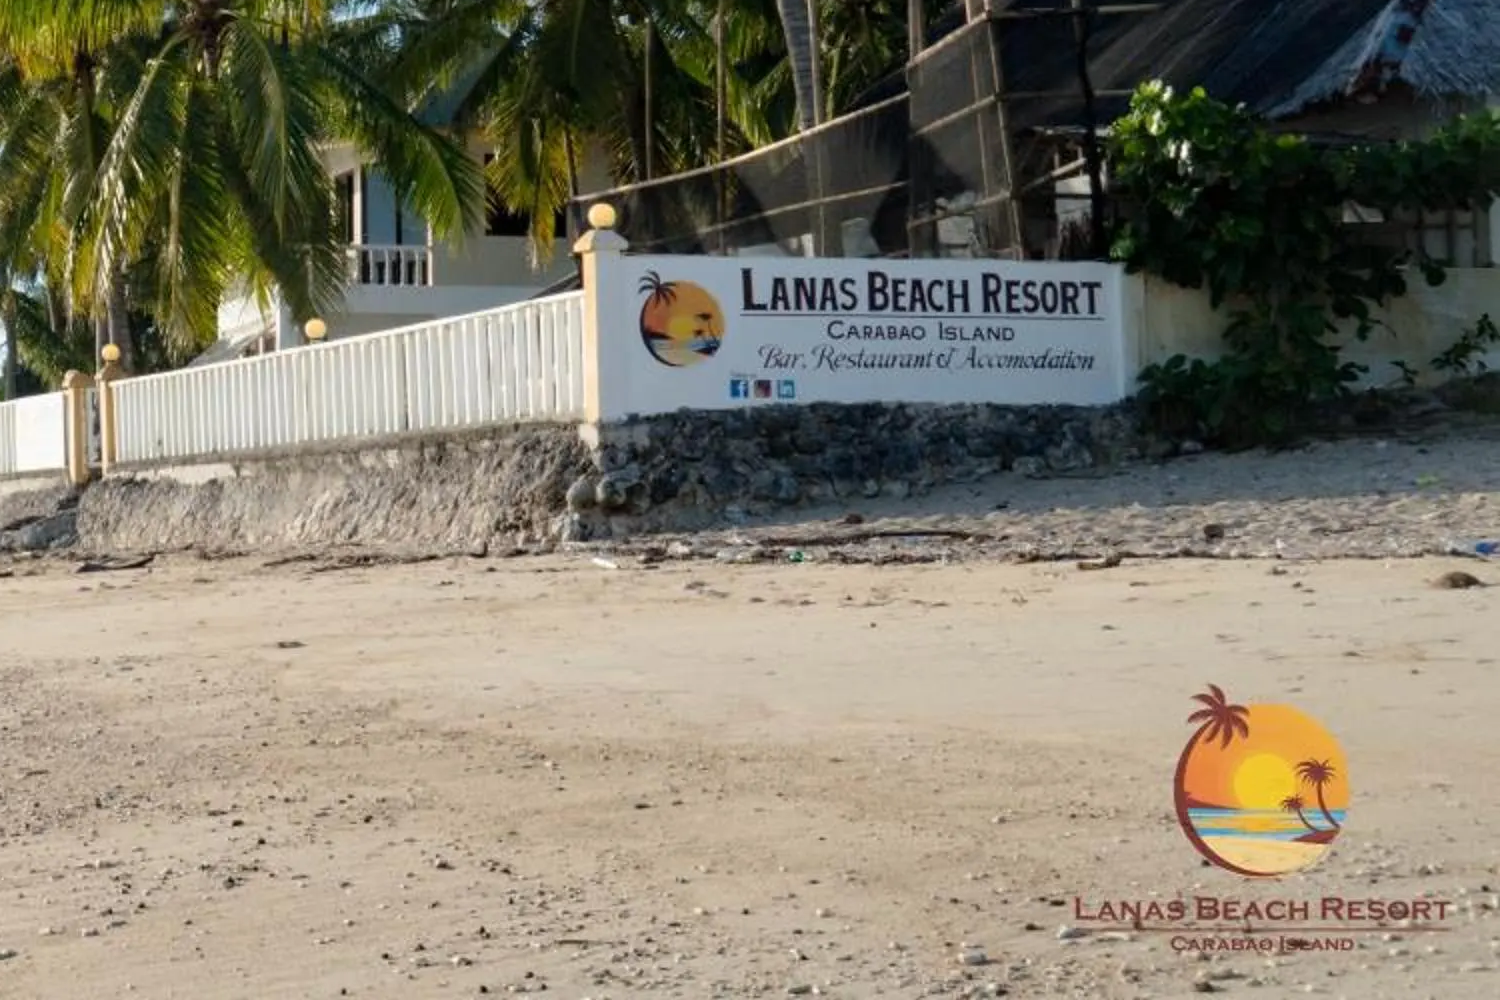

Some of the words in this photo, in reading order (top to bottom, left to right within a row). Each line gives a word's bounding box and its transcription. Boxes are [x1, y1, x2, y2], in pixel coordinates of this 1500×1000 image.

[741, 267, 858, 312] LANAS
[867, 270, 970, 313] BEACH
[981, 272, 1102, 315] RESORT
[827, 320, 926, 341] CARABAO
[938, 321, 1015, 342] ISLAND
[811, 344, 934, 372] Restaurant
[960, 345, 1095, 370] Accomodation
